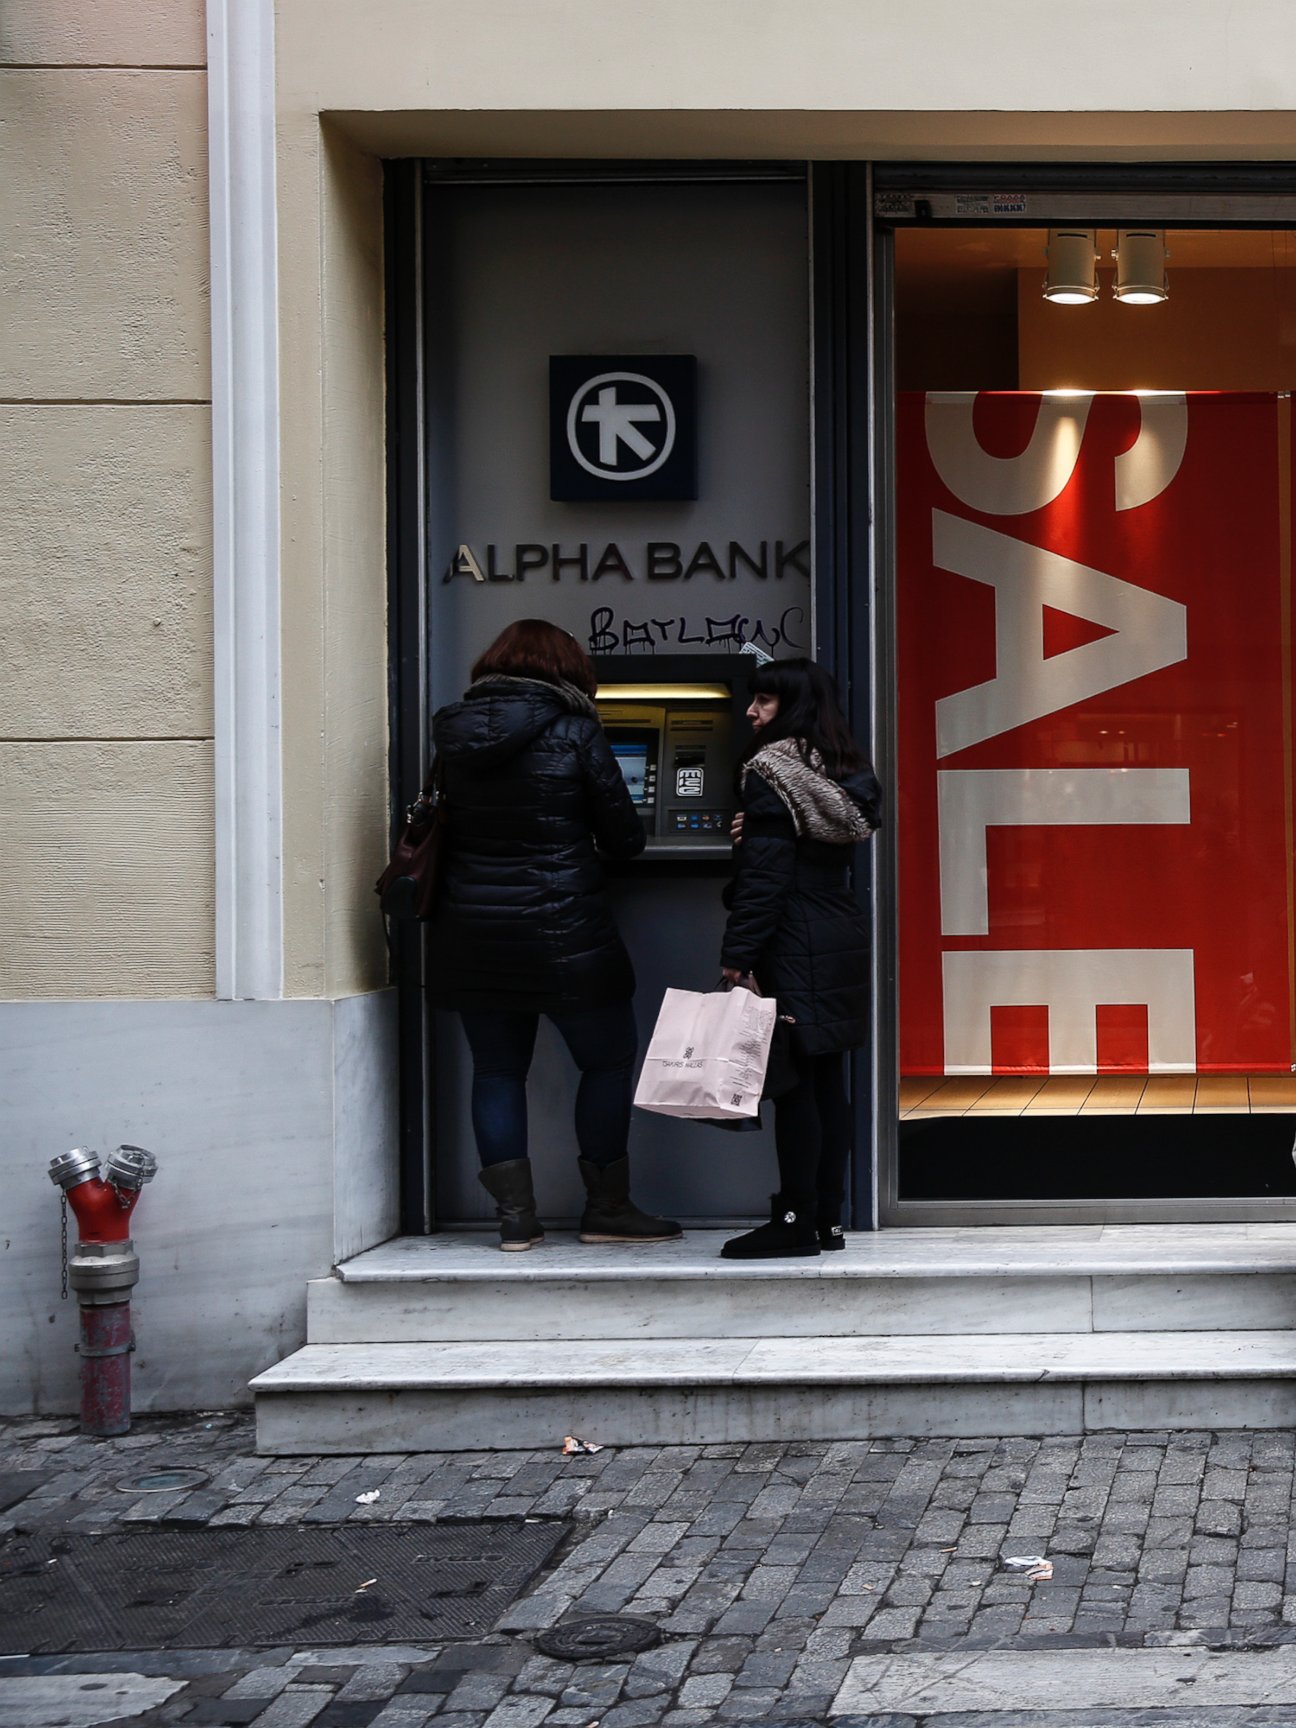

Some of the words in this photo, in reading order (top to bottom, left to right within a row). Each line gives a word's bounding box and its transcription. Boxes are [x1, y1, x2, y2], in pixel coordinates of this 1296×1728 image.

[443, 541, 634, 583] ALPHA
[646, 540, 811, 581] BANK
[925, 389, 1196, 1076] SALE
